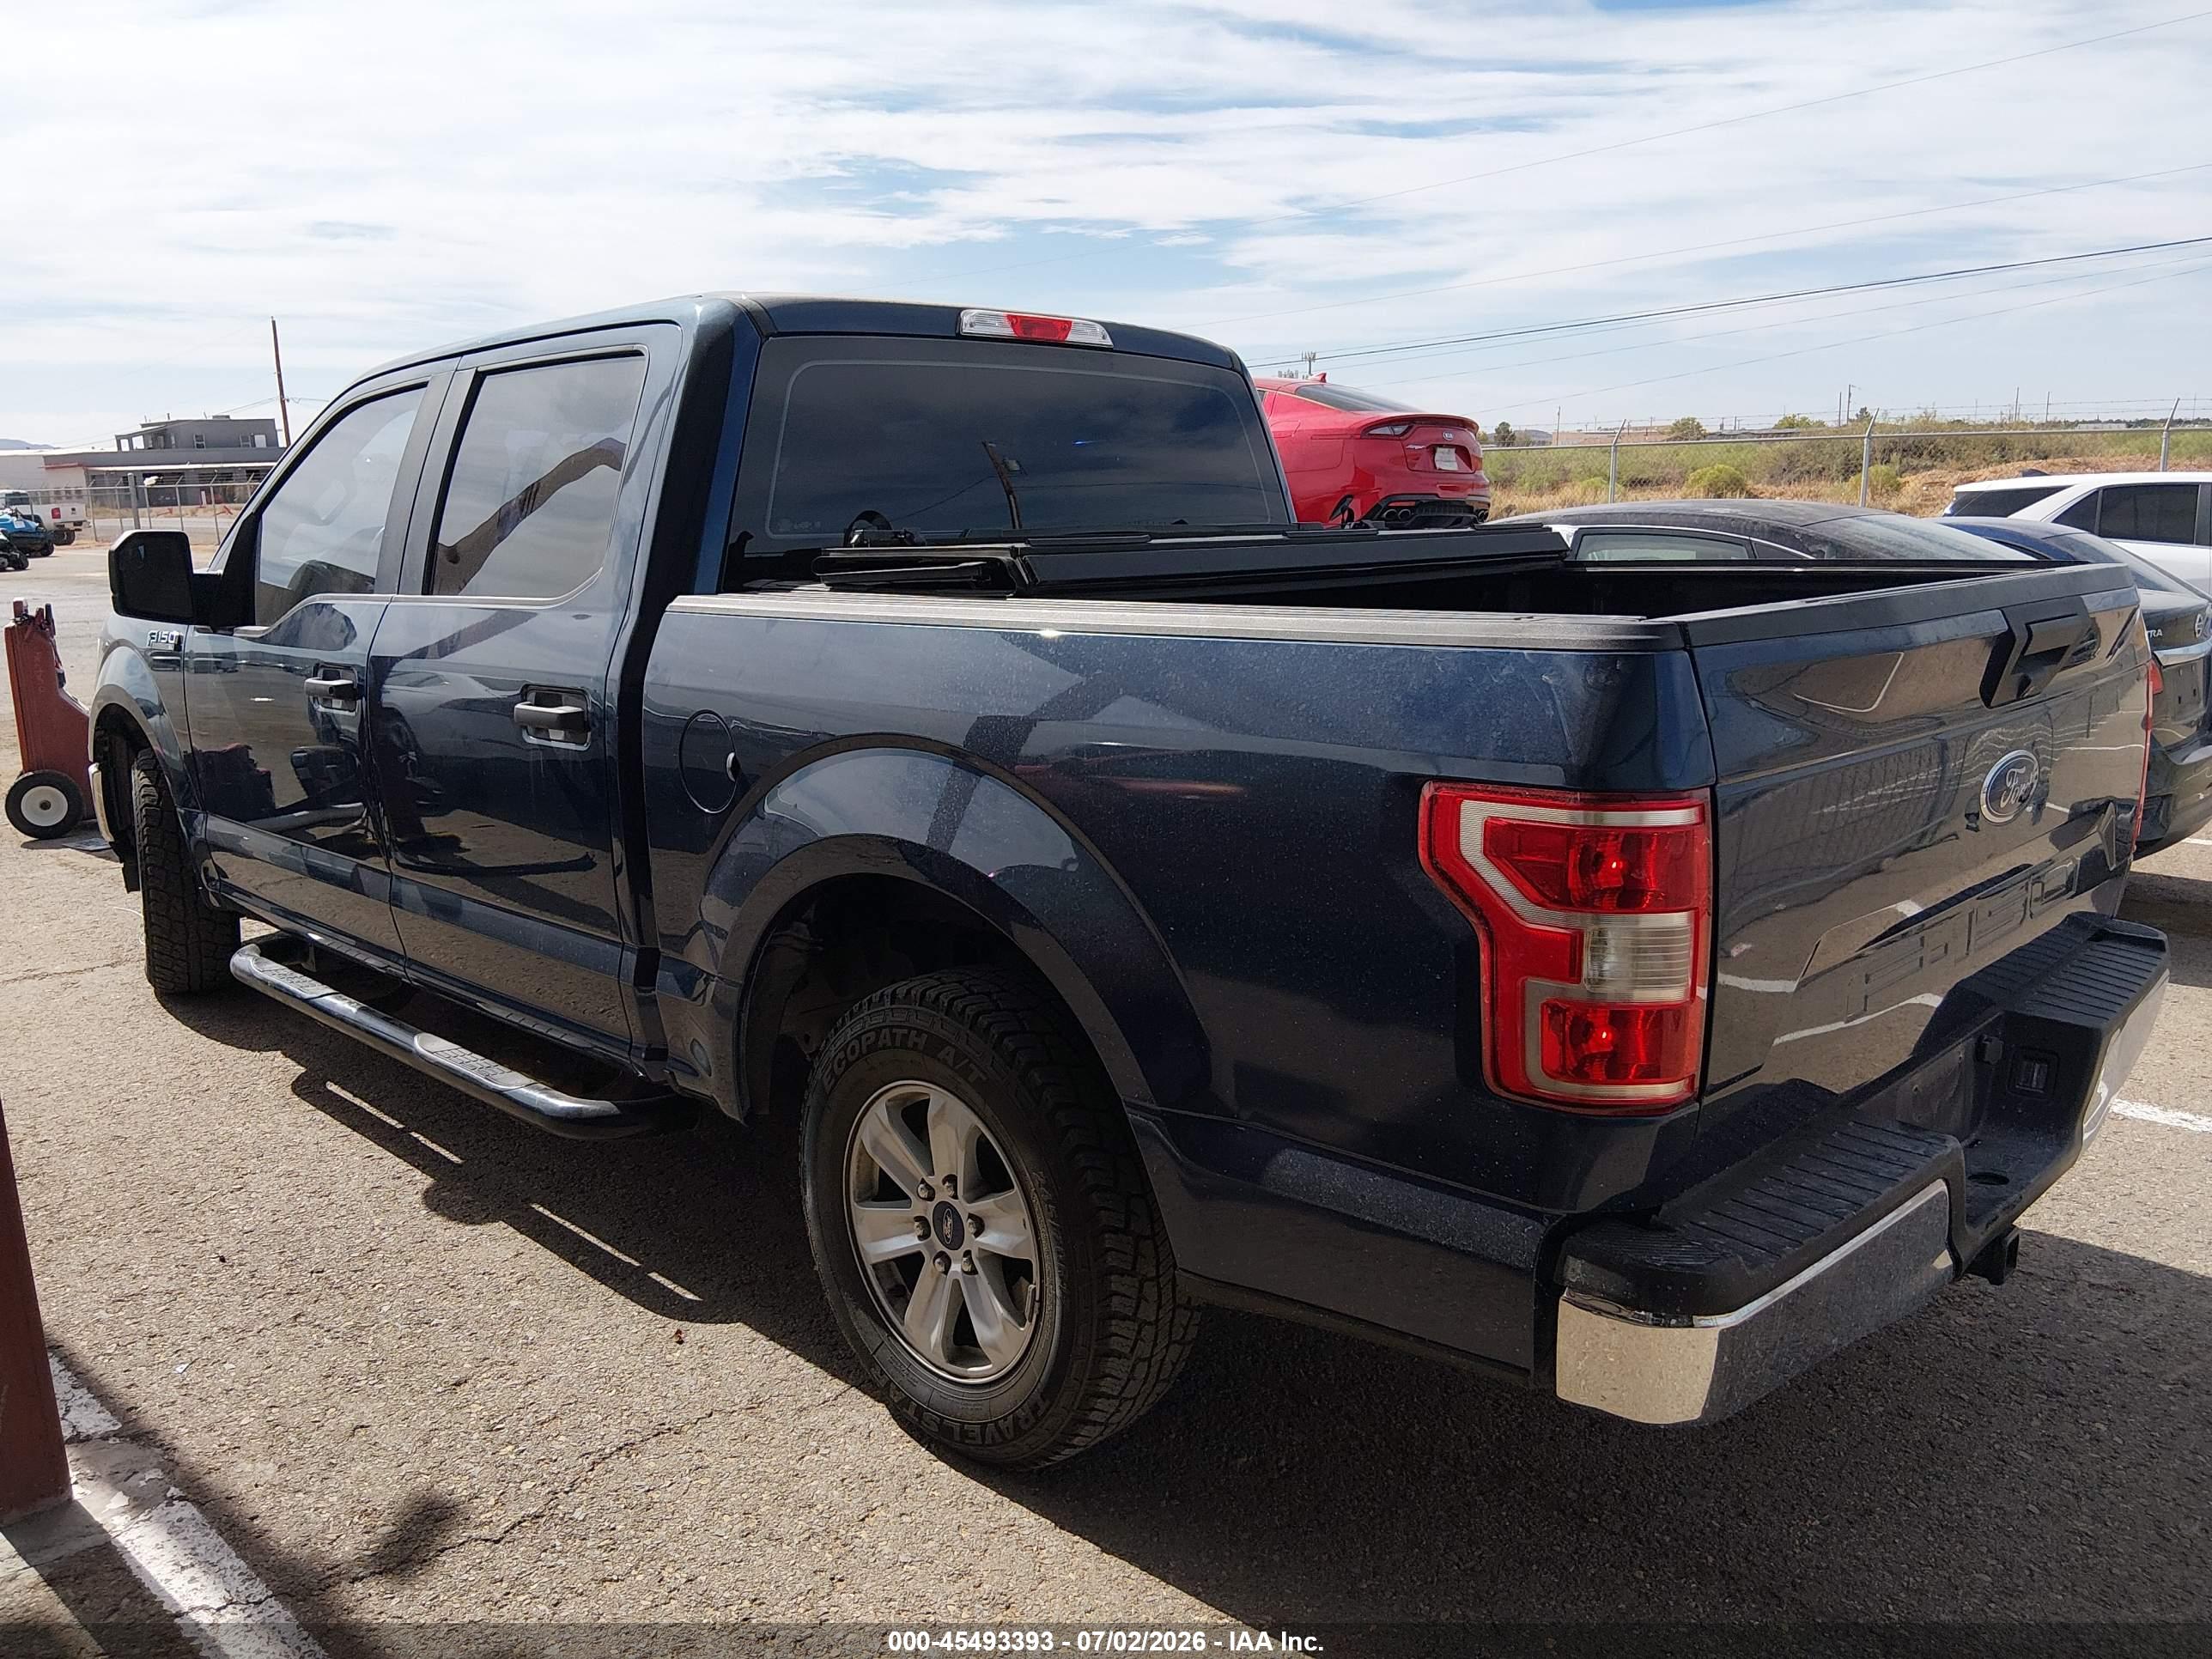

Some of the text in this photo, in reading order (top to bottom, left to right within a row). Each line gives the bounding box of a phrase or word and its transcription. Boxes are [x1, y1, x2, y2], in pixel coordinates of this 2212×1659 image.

[2000, 765, 2034, 809] Ford
[823, 1028, 987, 1091] ECOPATH A/T
